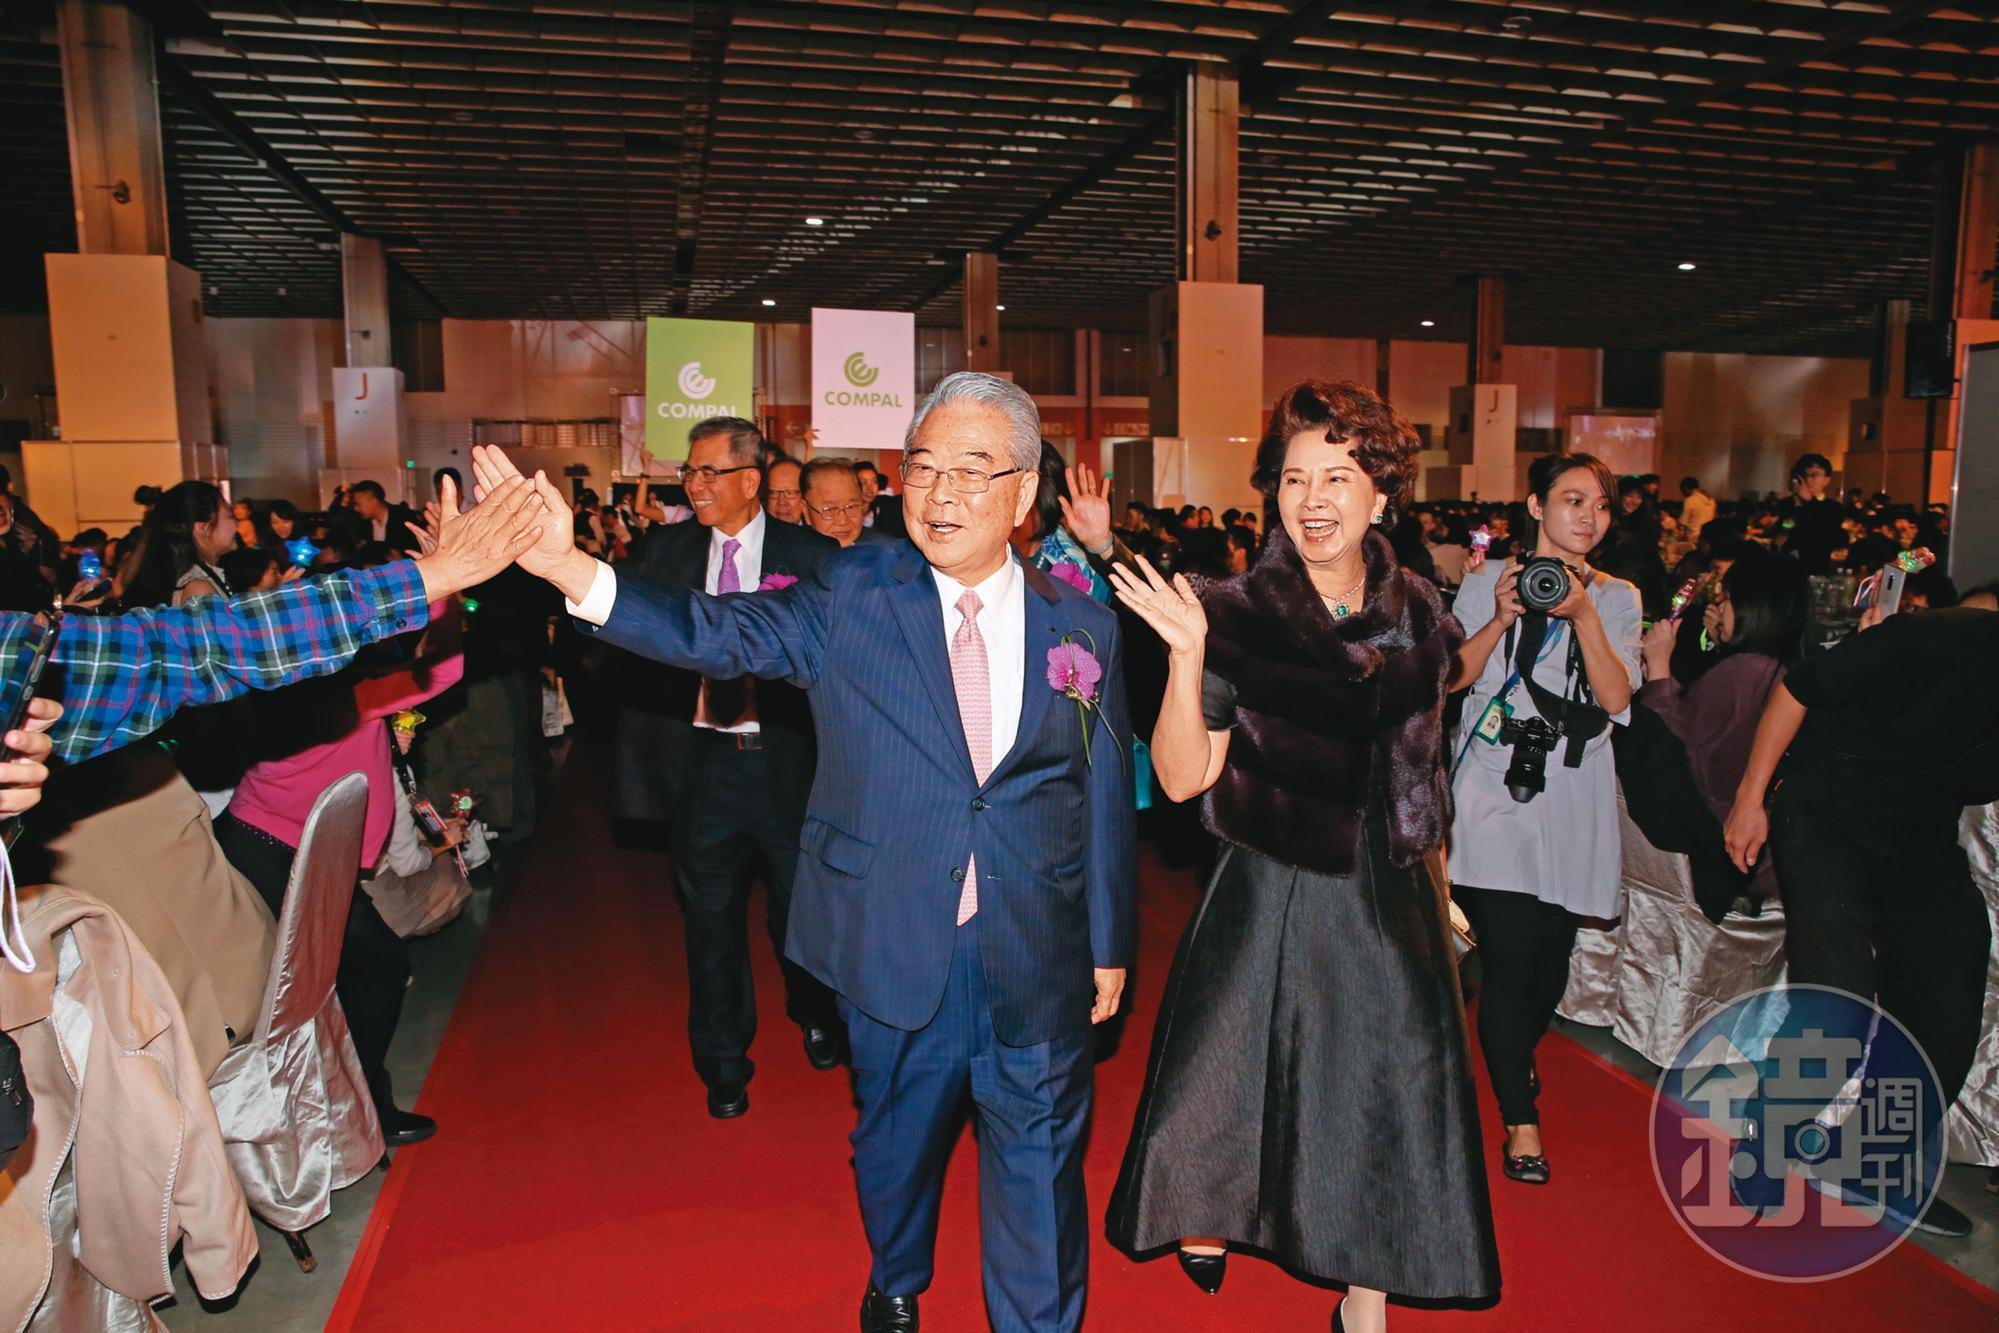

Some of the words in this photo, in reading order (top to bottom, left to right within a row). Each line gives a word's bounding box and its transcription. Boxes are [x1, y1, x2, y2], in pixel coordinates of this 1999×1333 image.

[354, 372, 368, 400] J
[824, 391, 903, 408] COMPAL
[1488, 389, 1499, 413] J
